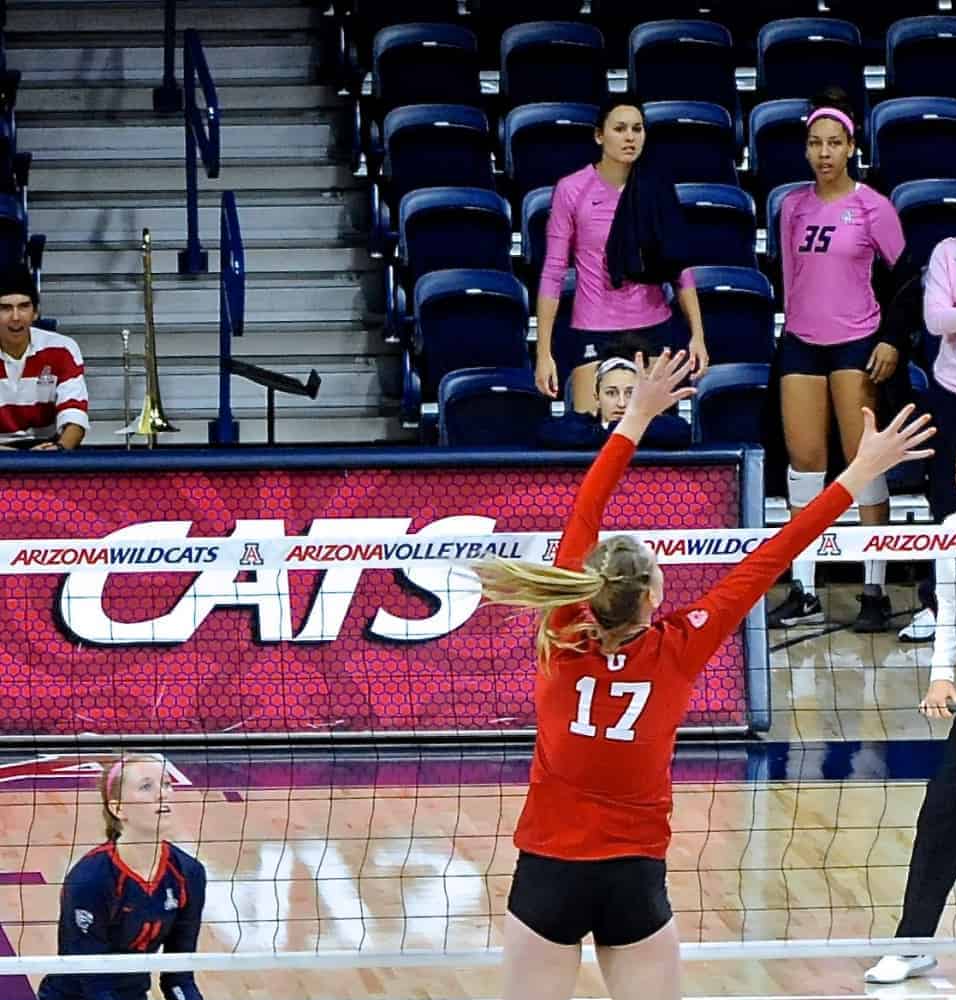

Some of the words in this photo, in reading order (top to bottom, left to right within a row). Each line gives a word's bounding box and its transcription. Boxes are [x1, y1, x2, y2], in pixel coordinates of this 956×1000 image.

[798, 225, 837, 253] 35
[239, 543, 265, 566] A
[816, 533, 842, 556] A
[57, 514, 498, 646] CATS
[569, 675, 652, 742] 17
